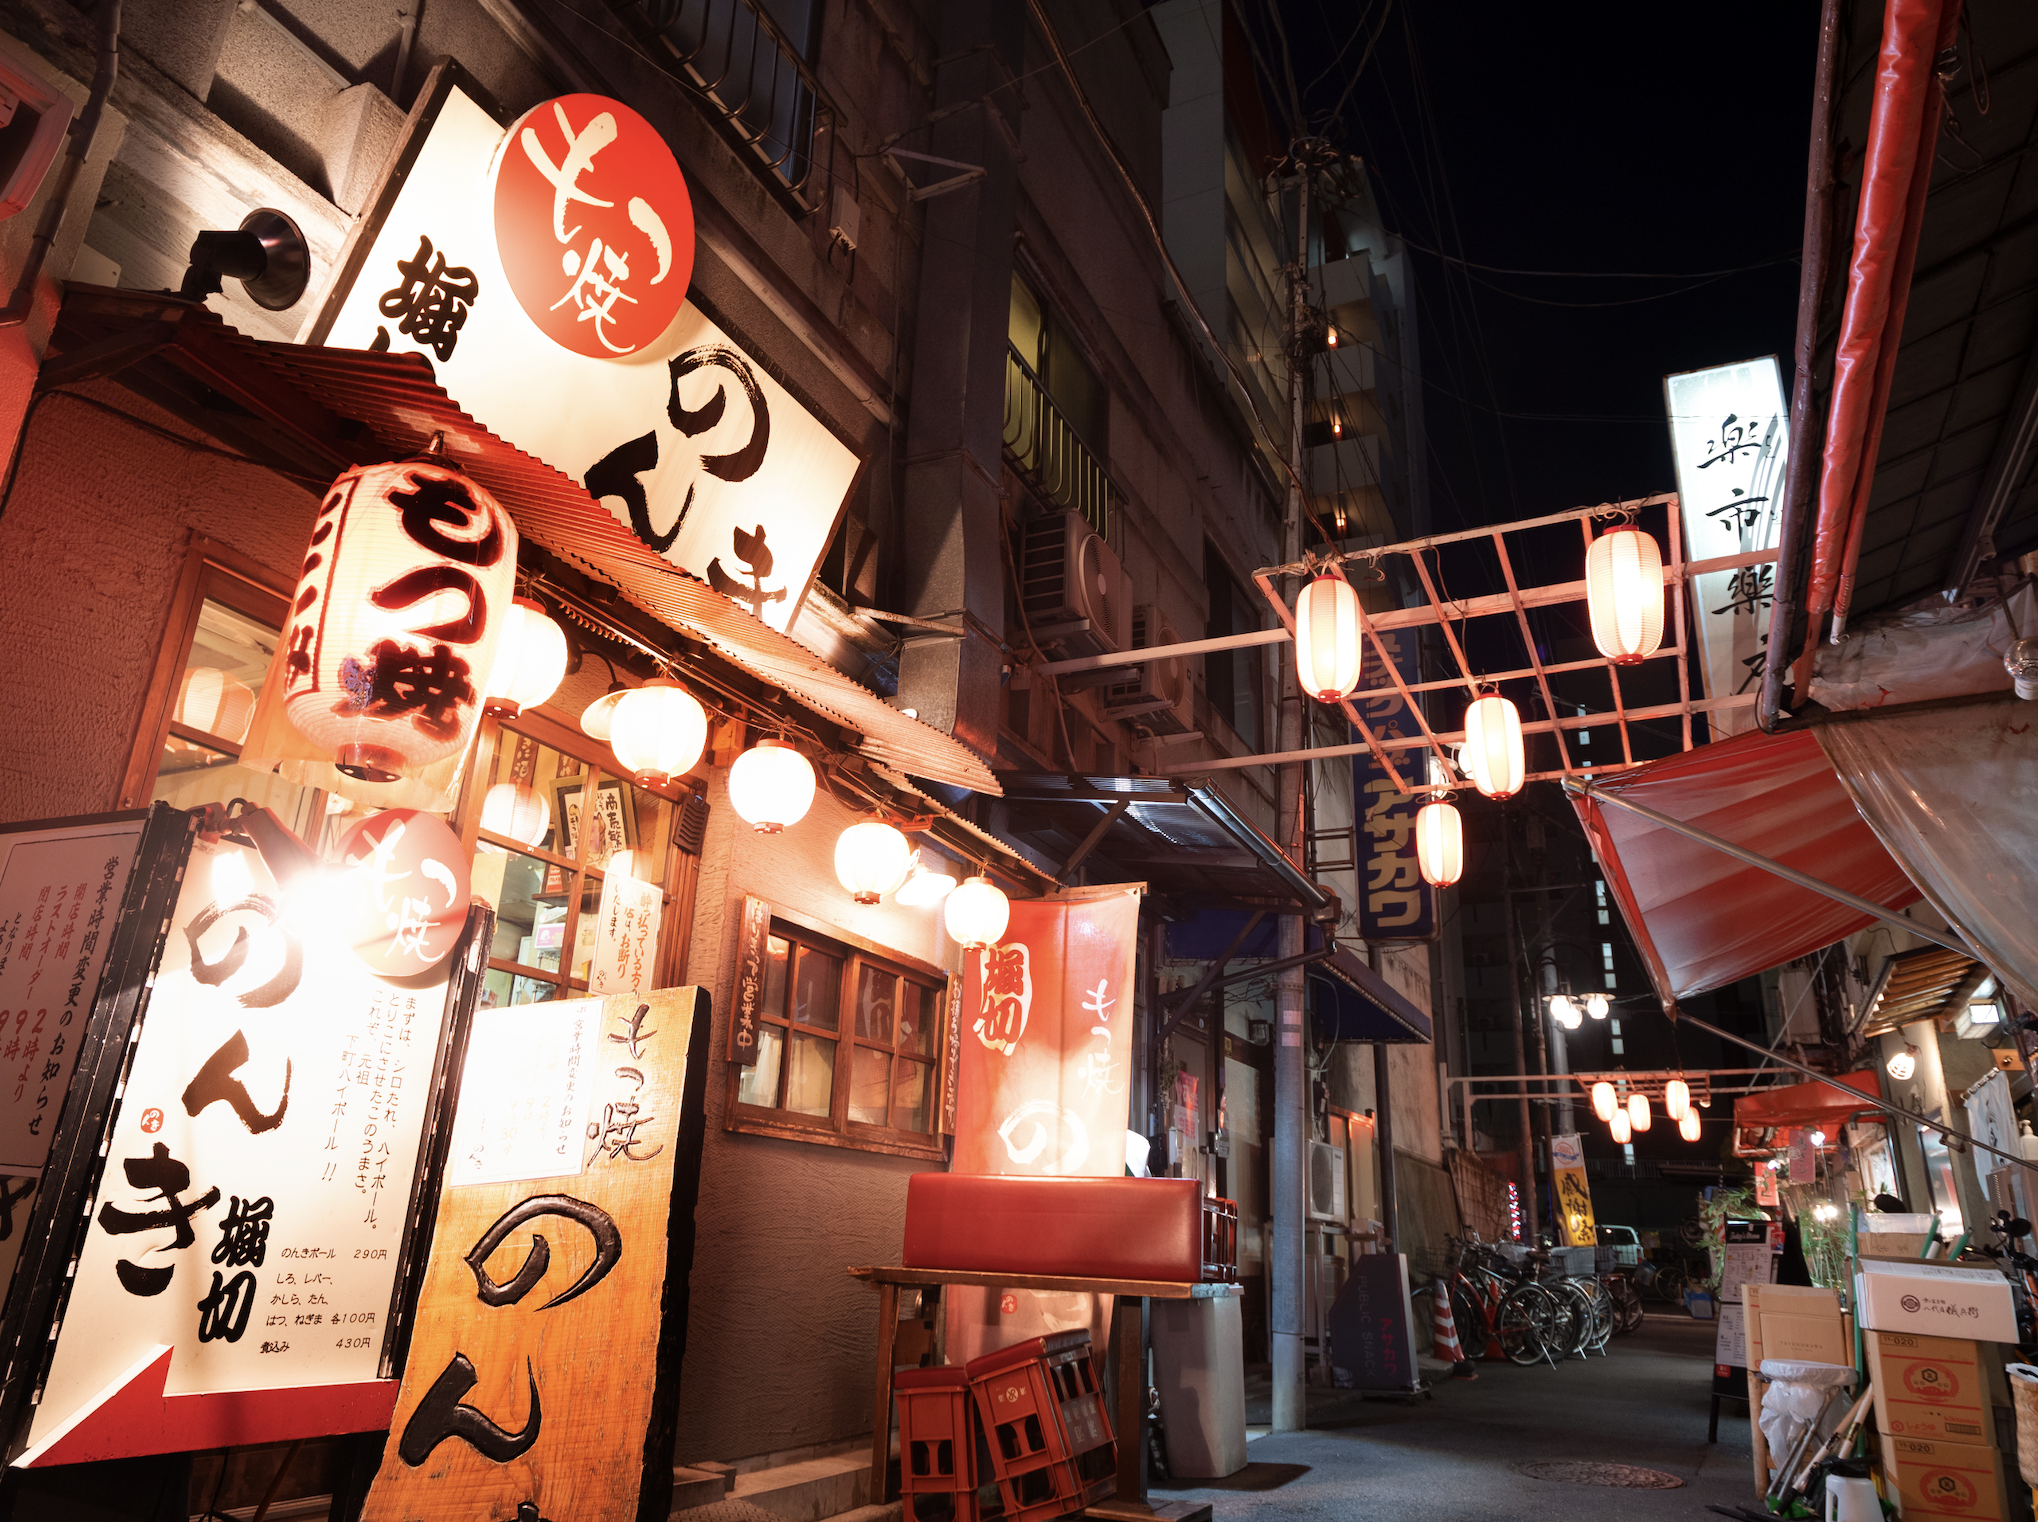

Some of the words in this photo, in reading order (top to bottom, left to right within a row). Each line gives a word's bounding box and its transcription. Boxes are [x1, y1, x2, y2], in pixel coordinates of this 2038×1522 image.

[521, 100, 672, 354] もつ焼
[347, 817, 459, 963] もつ焼
[1363, 775, 1421, 928] アサカワ
[18, 886, 51, 961] 閉店時間
[26, 885, 69, 1000] ラストオーダー
[54, 883, 88, 960] 開店時間
[3, 1009, 28, 1061] 9時
[27, 855, 120, 1136] 営業時間変更のお知らせ
[980, 946, 1026, 1048] 堀切
[1077, 979, 1126, 1099] もつ焼
[13, 1008, 47, 1104] 2時より
[100, 893, 304, 1298] のんき
[586, 1003, 664, 1168] もつ焼
[197, 1195, 274, 1344] 堀切
[353, 1249, 387, 1260] 290円
[1357, 1275, 1372, 1324] PUBLIC
[335, 1337, 371, 1349] 430円
[1362, 1331, 1376, 1377] SNACK
